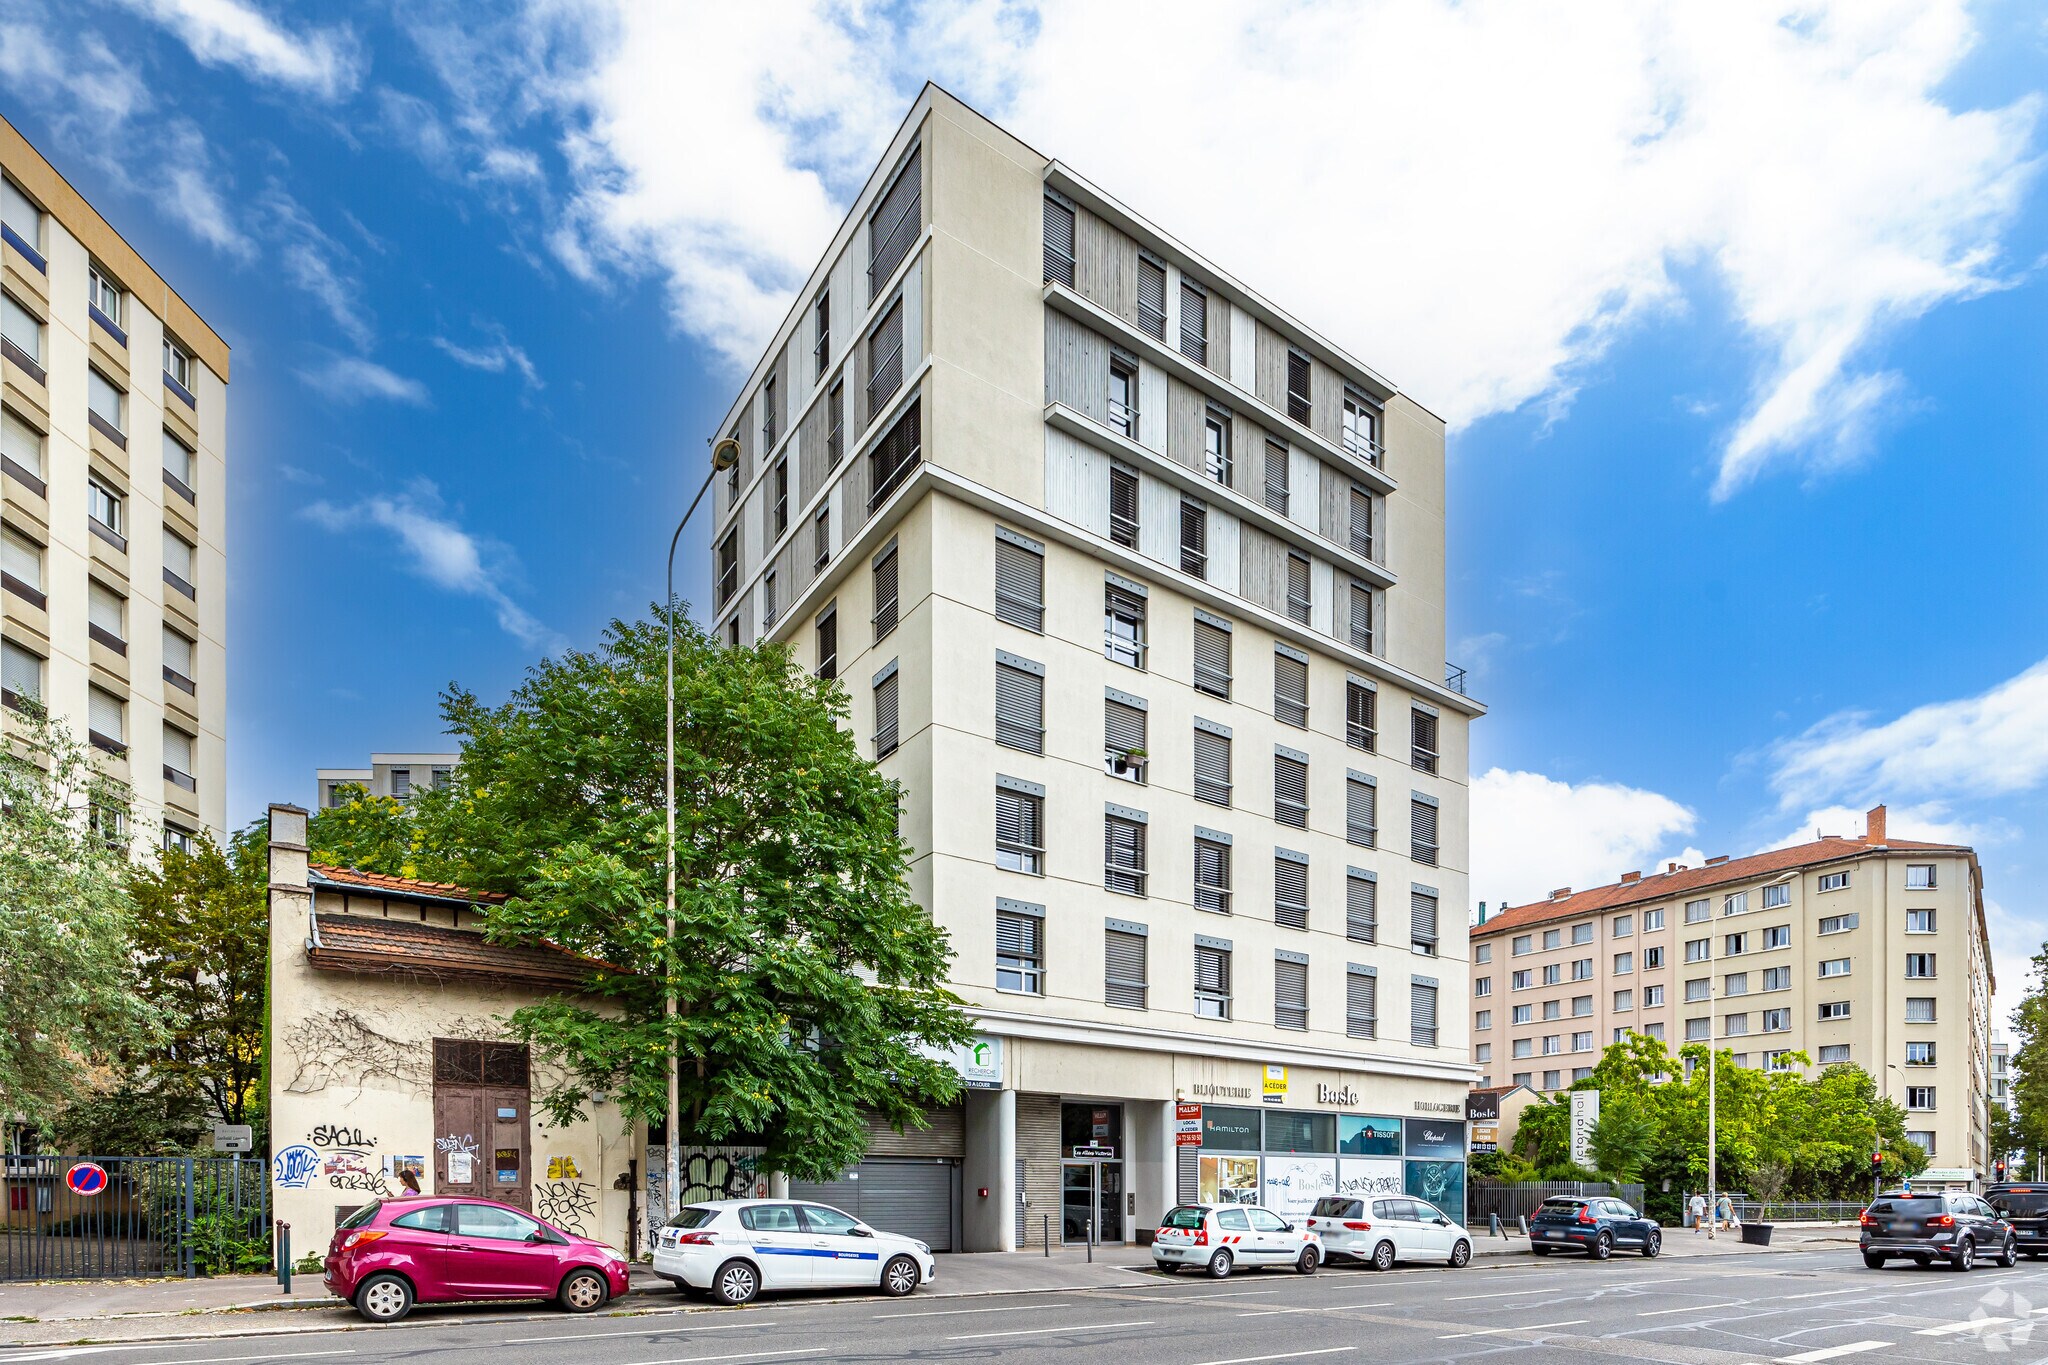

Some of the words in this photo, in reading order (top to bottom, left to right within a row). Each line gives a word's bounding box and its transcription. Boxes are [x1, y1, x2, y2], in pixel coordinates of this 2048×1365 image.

[968, 1067, 996, 1075] RECHERCHE
[1193, 1083, 1252, 1098] BIJOUTERIE
[1317, 1083, 1360, 1105] Bosle
[1414, 1101, 1461, 1113] HORLOGERIE
[1470, 1108, 1496, 1118] Bosle
[1210, 1125, 1250, 1133] HAMILTON
[1574, 1093, 1584, 1161] ictoriahall
[1422, 1129, 1446, 1143] Chopard
